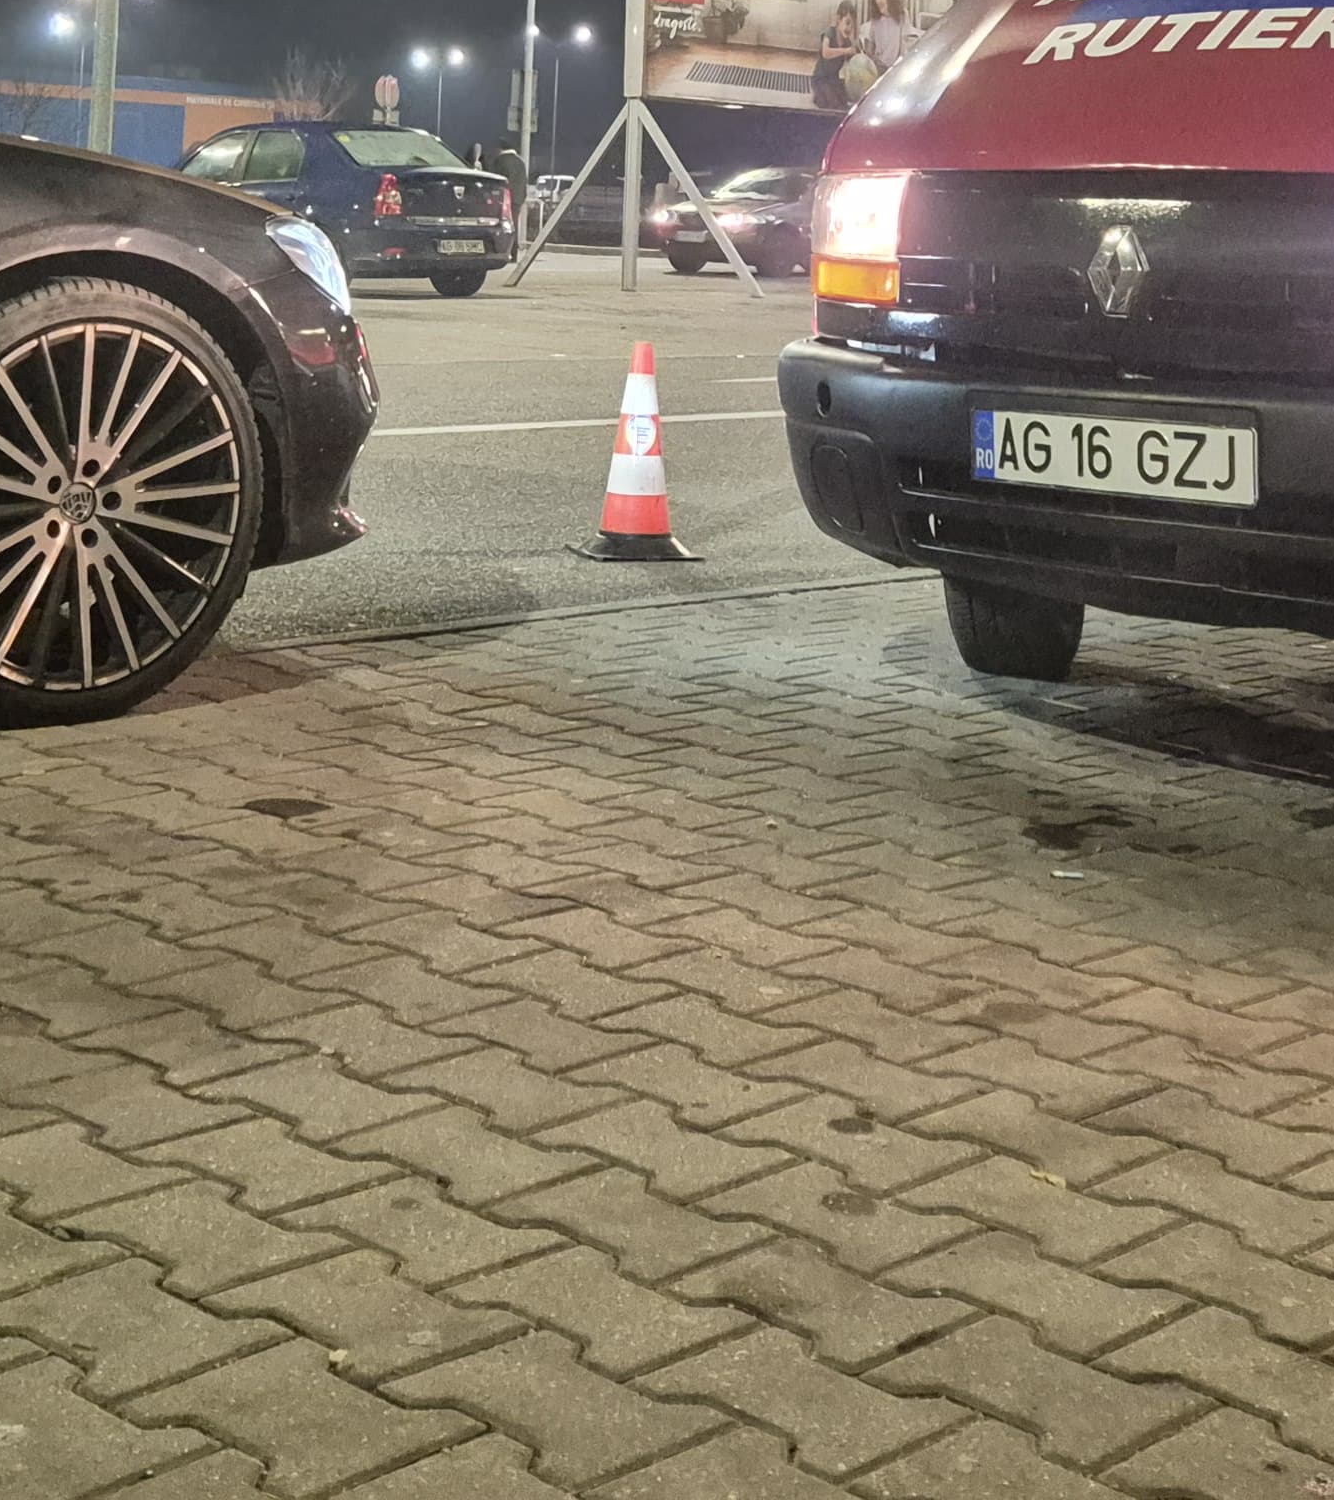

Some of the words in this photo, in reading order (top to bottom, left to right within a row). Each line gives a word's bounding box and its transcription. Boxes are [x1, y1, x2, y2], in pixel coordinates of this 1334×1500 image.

[976, 447, 994, 470] RO
[999, 417, 1052, 473] AG
[1072, 423, 1112, 479] 16
[1137, 430, 1236, 491] GZJ
